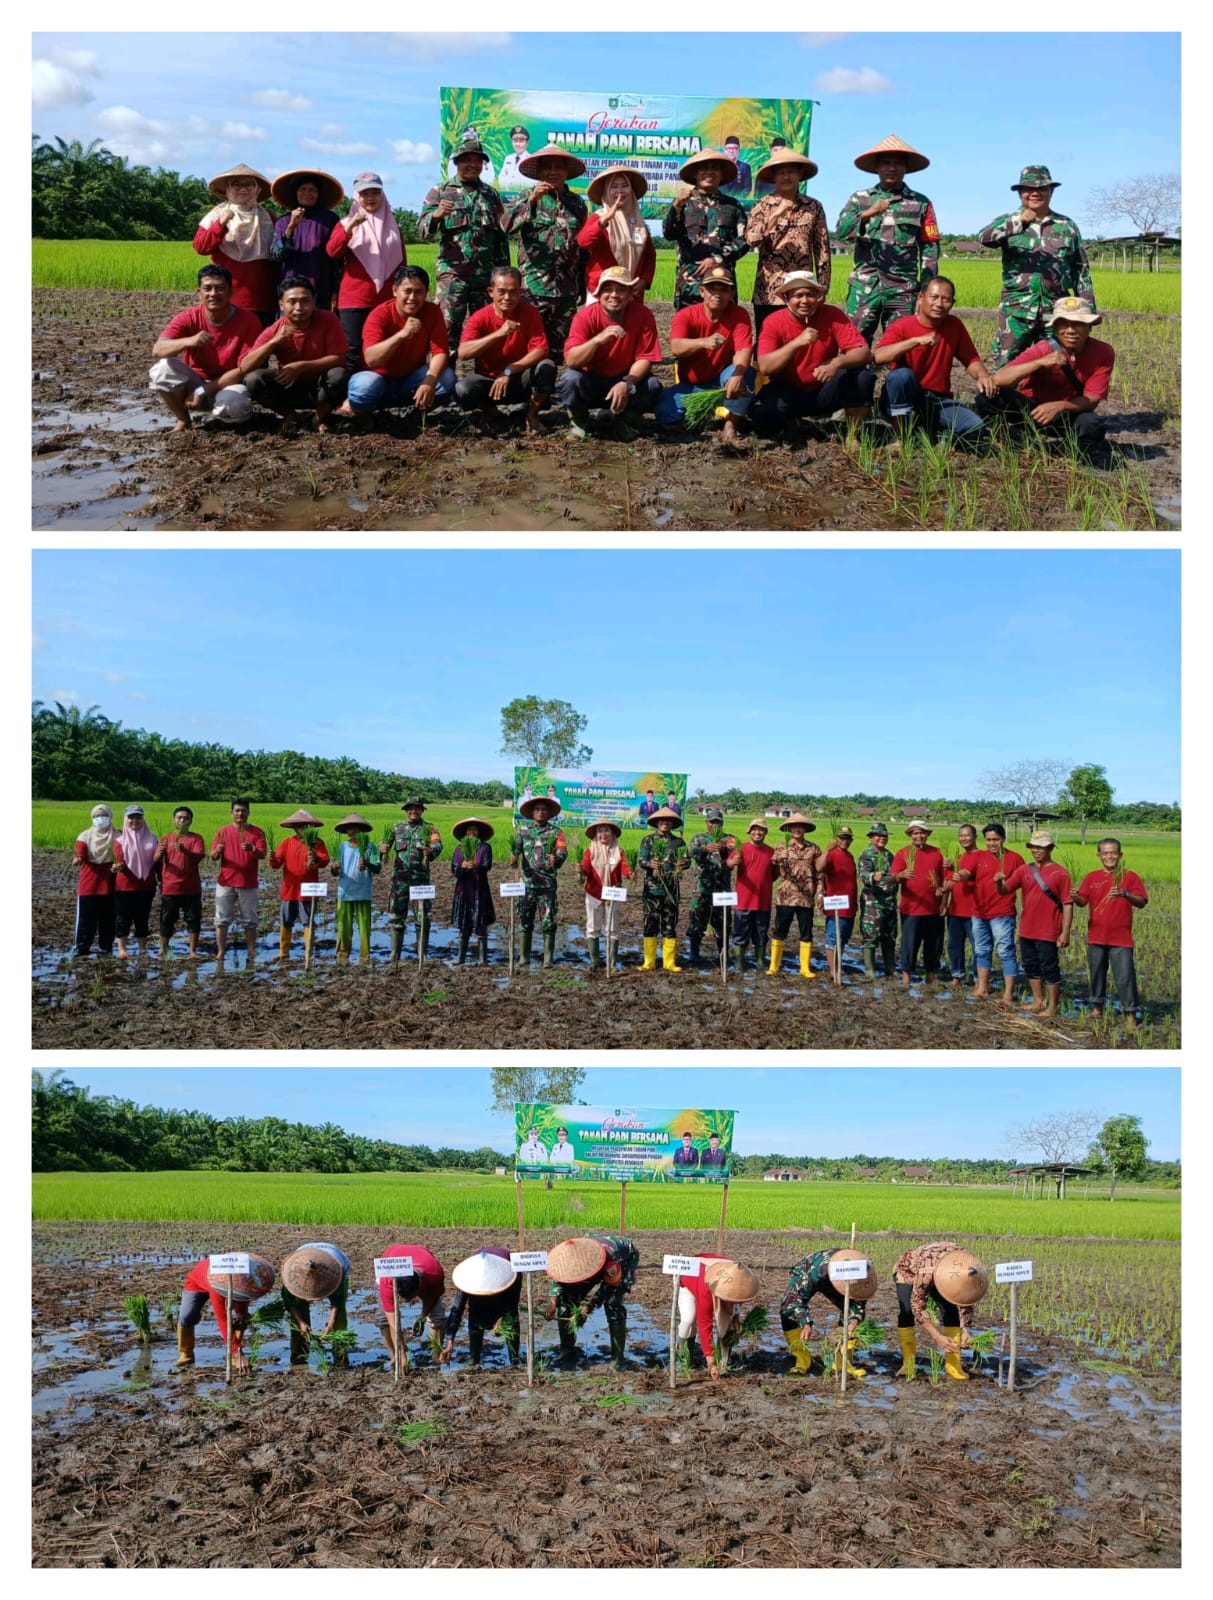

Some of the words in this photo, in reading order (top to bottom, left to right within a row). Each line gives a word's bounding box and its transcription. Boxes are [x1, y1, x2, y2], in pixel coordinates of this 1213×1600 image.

[586, 111, 660, 134] Gerakan
[547, 132, 597, 152] TANAM
[600, 133, 633, 153] PADI
[636, 135, 701, 155] BERSAMA
[641, 160, 663, 169] TANAM
[579, 1130, 608, 1142] TANAM
[609, 1131, 629, 1144] PADI
[630, 1132, 669, 1145] BERSAMA
